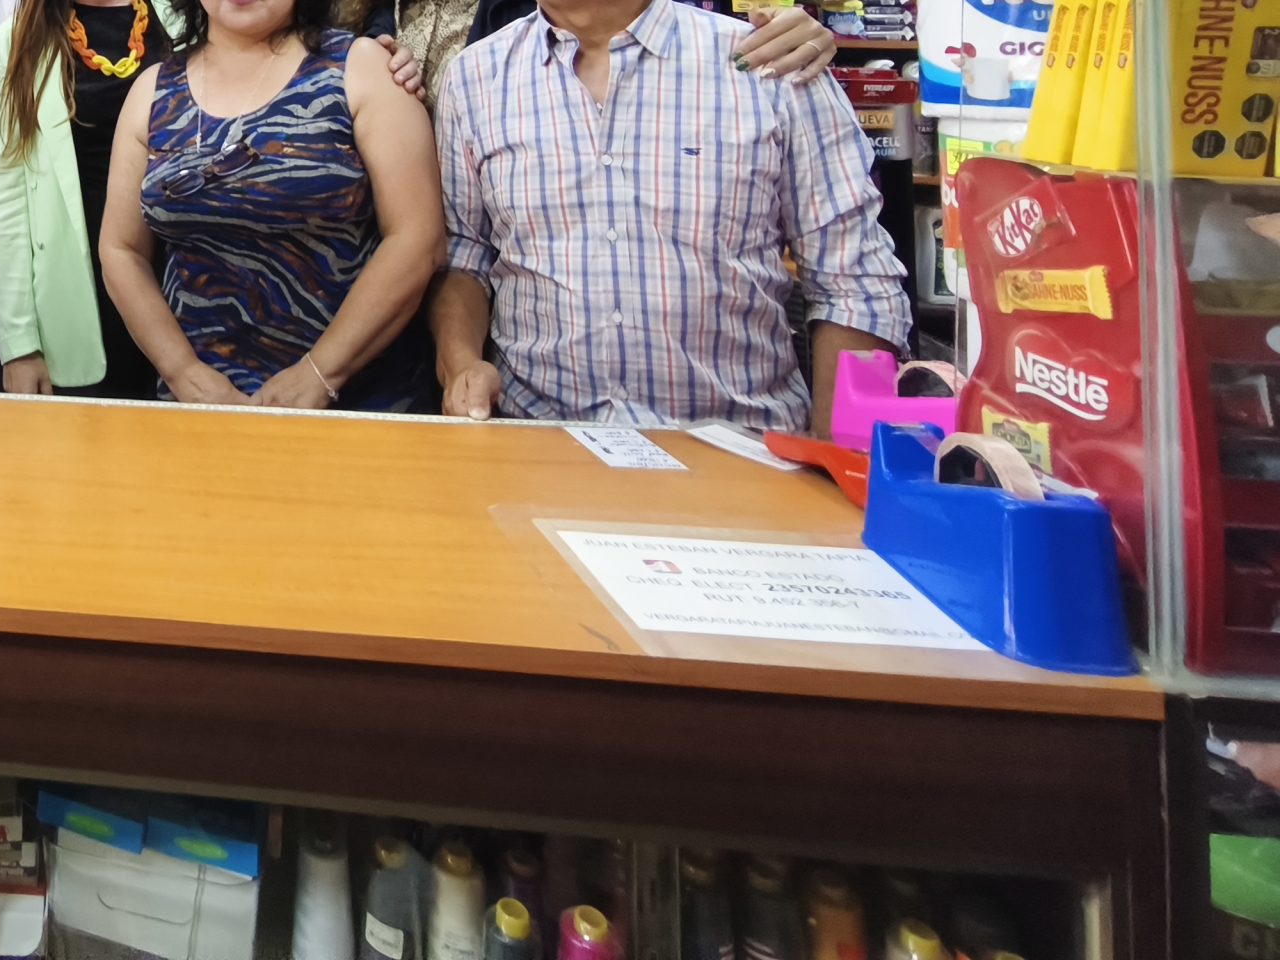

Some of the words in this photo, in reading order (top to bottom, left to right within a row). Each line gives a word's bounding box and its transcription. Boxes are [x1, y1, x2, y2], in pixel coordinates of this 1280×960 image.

[999, 41, 1045, 57] GIG
[858, 114, 891, 126] UEVA
[869, 136, 901, 148] ACELL
[995, 198, 1041, 257] KitKat
[1028, 282, 1088, 303] SAHNE-NUSS
[633, 540, 718, 554] ESTEBAN
[692, 566, 761, 578] BANCO
